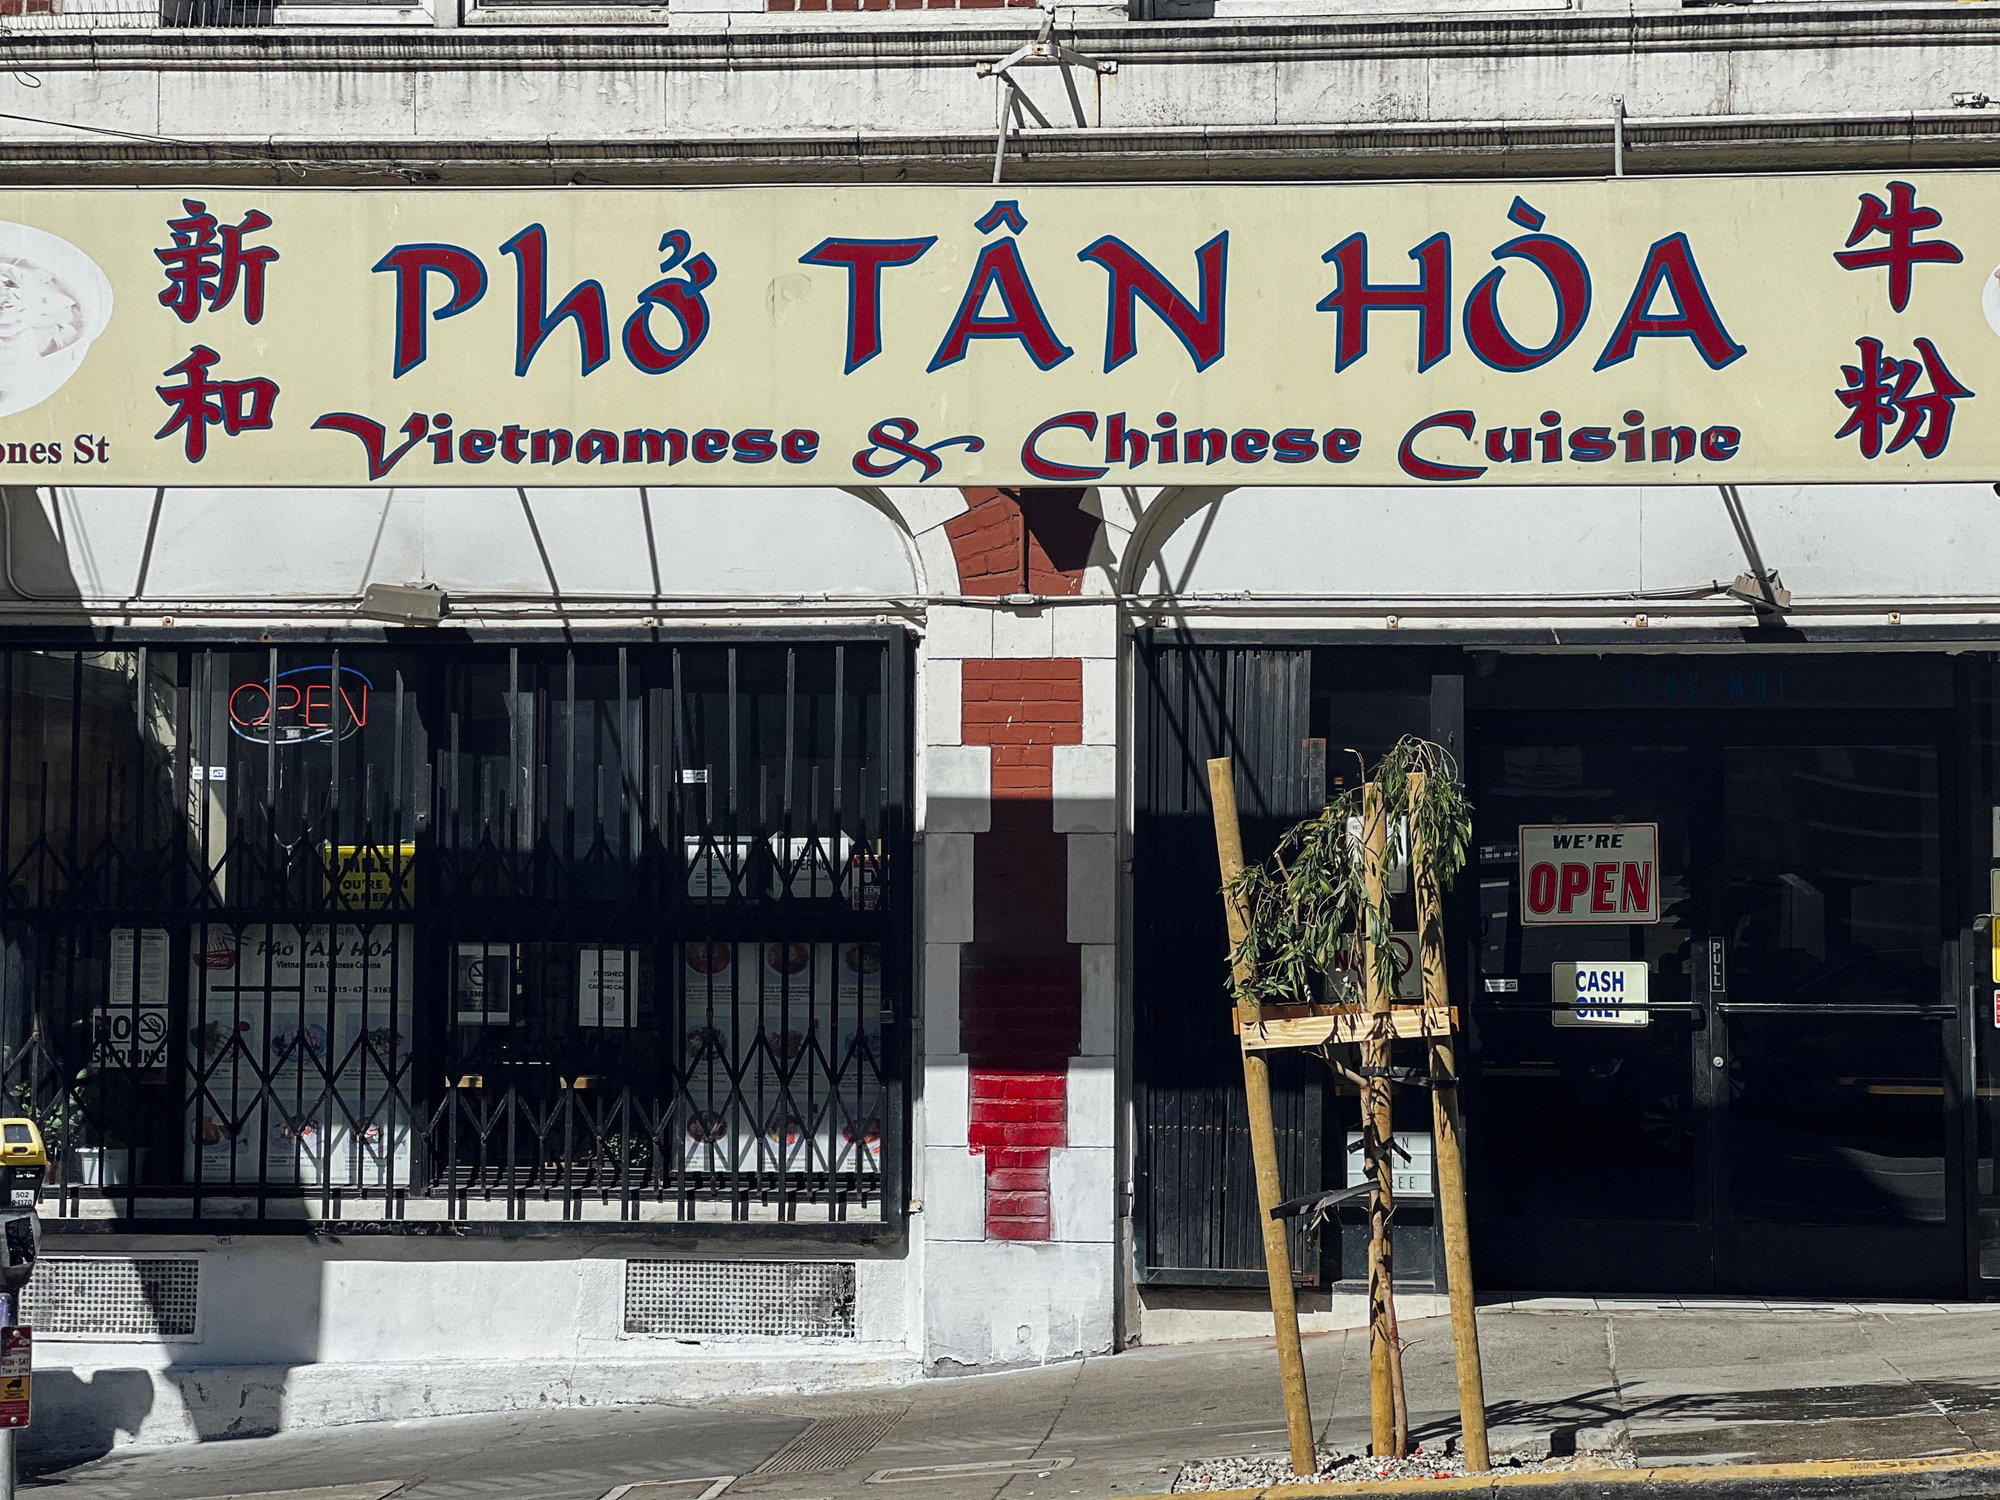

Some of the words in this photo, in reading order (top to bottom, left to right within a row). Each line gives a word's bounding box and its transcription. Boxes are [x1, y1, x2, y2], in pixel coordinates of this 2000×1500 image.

[799, 199, 1229, 376] TÂN
[1316, 195, 1748, 373] HÒA
[154, 199, 279, 462] 新和
[1833, 180, 1975, 460] 牛粉
[74, 434, 110, 464] St
[311, 411, 819, 482] Vietnamese
[852, 416, 985, 483] &
[1021, 410, 1361, 482] Chinese
[1398, 409, 1742, 482] Cuisine
[230, 683, 368, 727] OPEN
[1552, 833, 1624, 849] WE'RE
[1528, 861, 1652, 915] OPEN
[276, 960, 319, 970] Vietnaese
[1575, 971, 1625, 993] CASH
[1712, 942, 1721, 986] PULL
[1576, 996, 1624, 1018] ONLY
